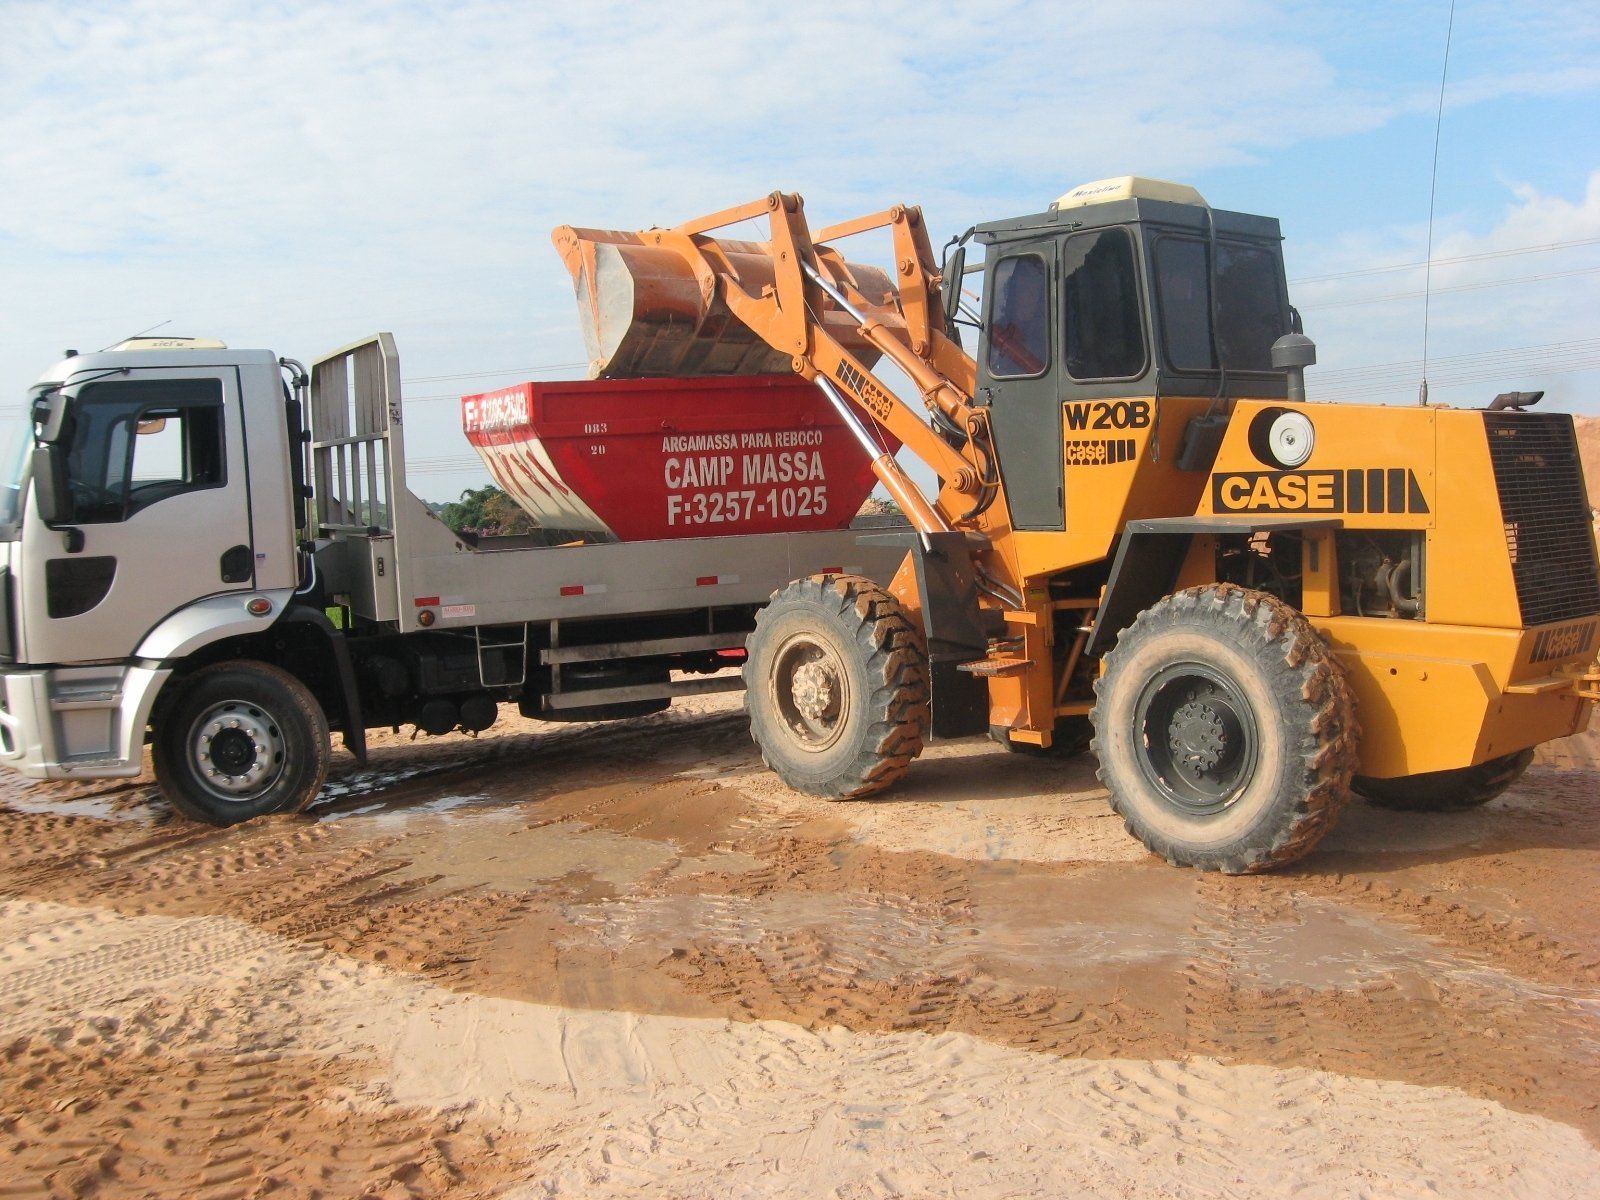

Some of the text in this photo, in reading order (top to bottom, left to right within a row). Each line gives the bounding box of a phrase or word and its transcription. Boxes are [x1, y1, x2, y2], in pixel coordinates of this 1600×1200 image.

[584, 422, 608, 434] 083
[1064, 401, 1151, 430] W20B
[590, 444, 606, 455] 20
[662, 430, 823, 452] ARGAMASSA PARA REBOCO
[664, 451, 826, 489] CAMP MASSA
[1220, 474, 1335, 510] CASE
